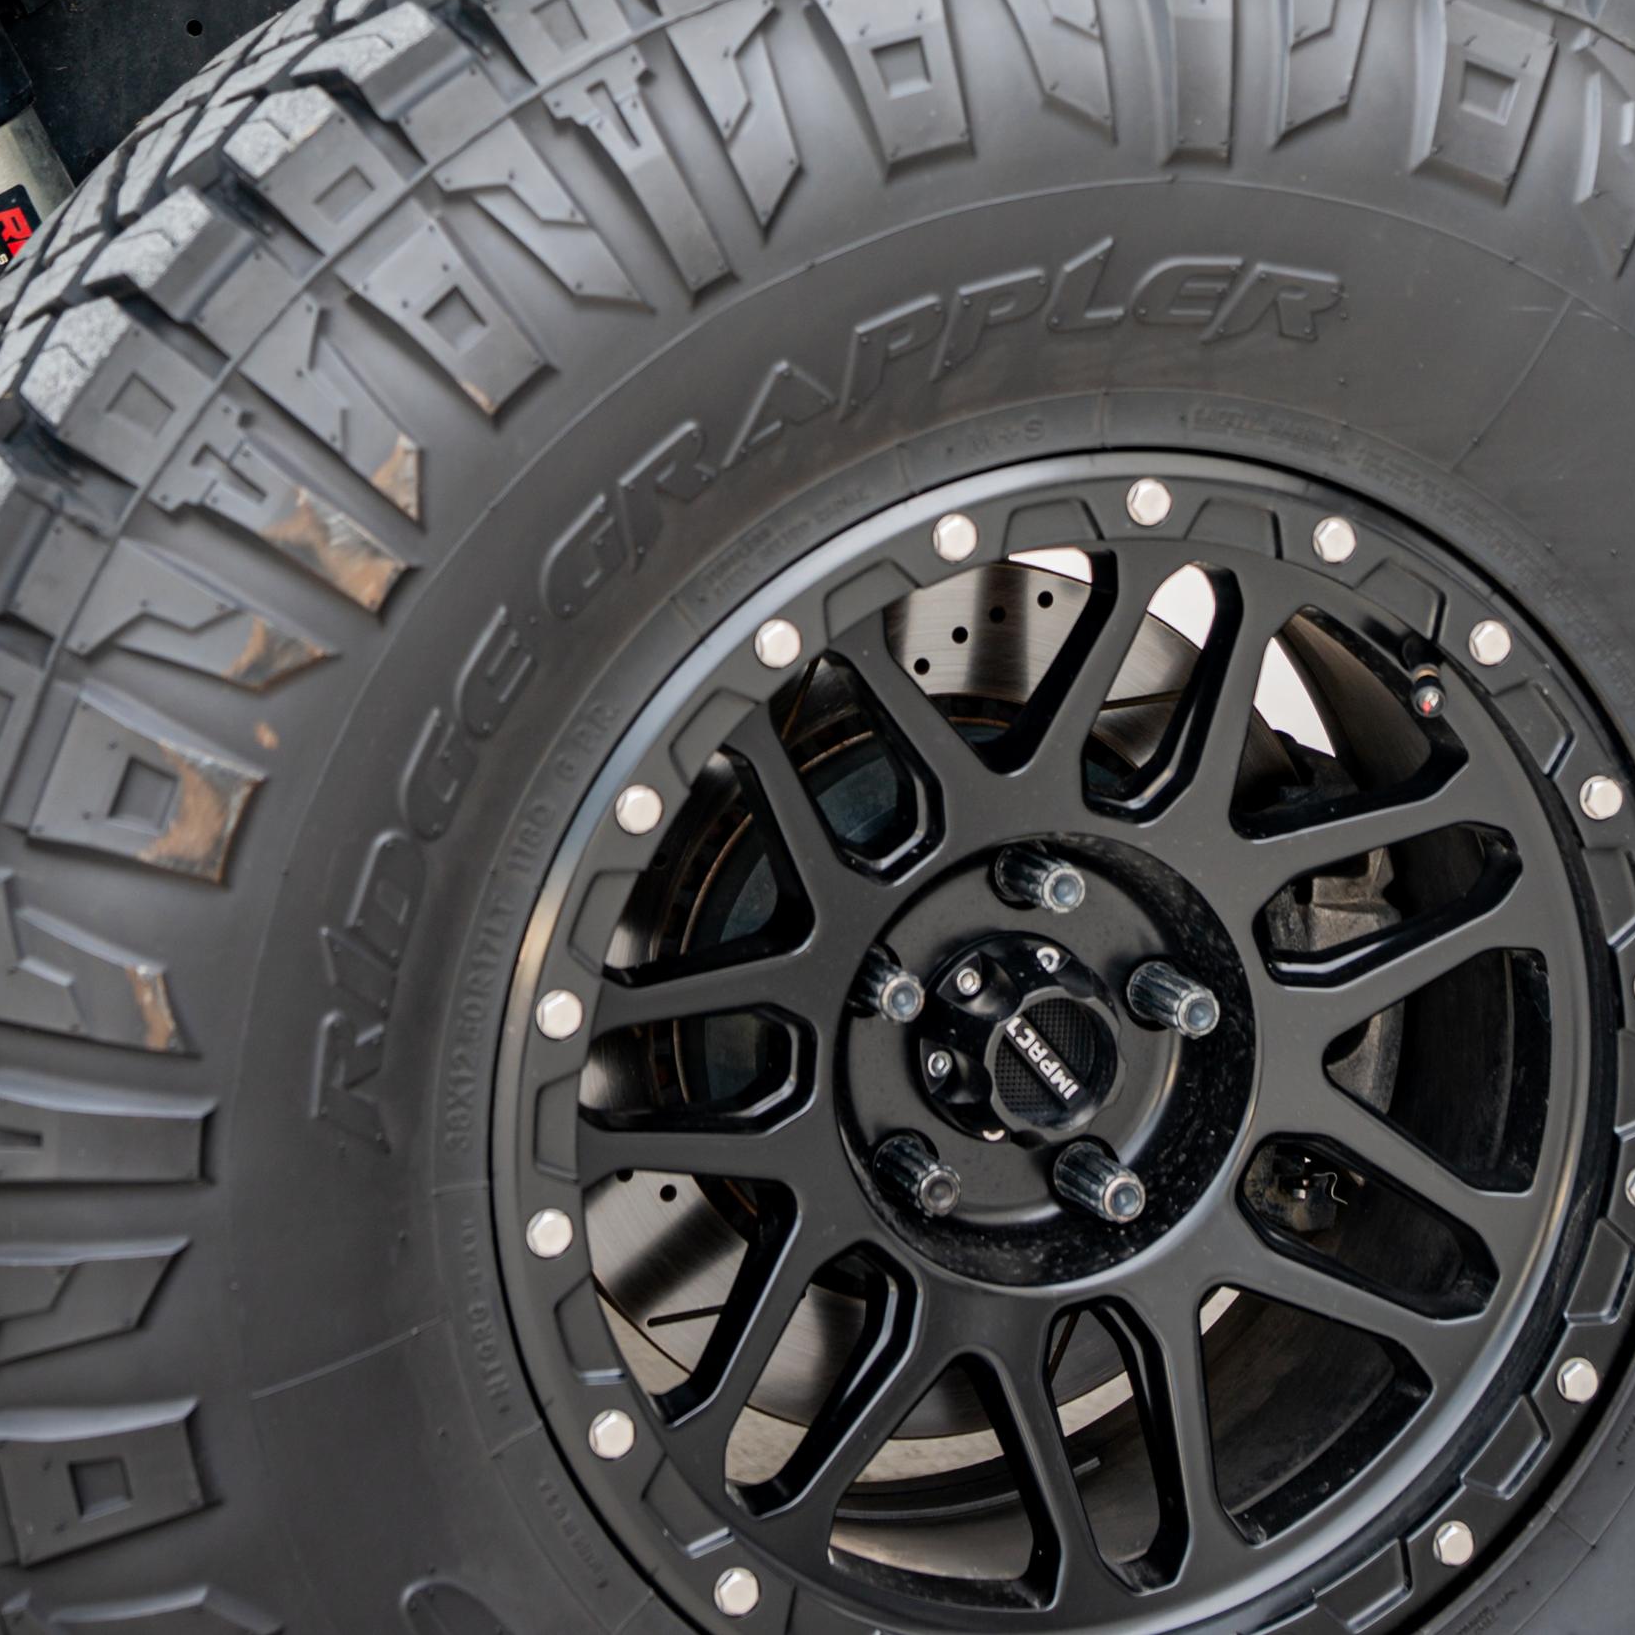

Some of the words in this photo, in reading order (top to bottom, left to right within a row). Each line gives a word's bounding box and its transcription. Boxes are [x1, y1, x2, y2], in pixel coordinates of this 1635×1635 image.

[309, 604, 538, 1154] RIDGE
[538, 235, 1351, 622] GRAPPLER
[1004, 1016, 1079, 1100] IMPACT
